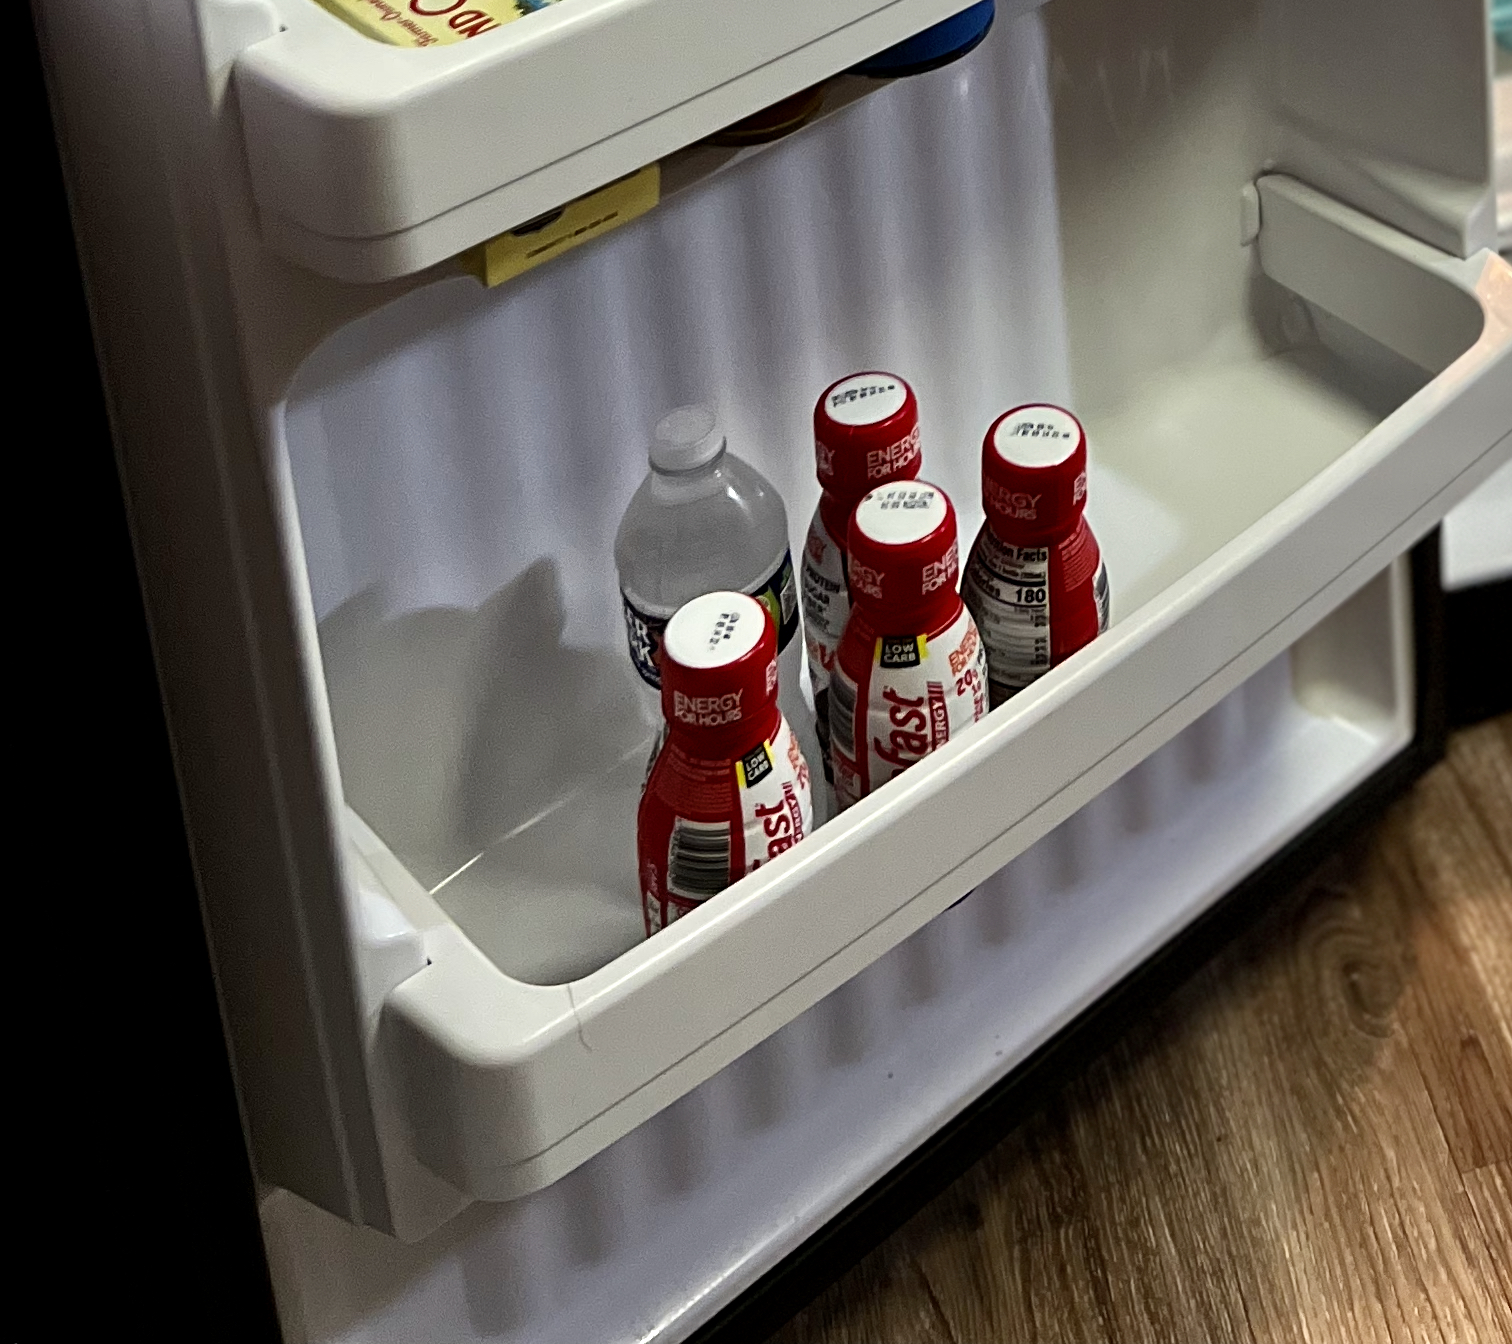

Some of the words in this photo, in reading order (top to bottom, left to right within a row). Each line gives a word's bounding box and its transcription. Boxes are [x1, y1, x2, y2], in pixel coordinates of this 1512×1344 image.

[448, 8, 502, 39] ND
[866, 422, 921, 468] ENERG
[867, 462, 892, 480] FOR
[1016, 547, 1047, 562] Facts
[1015, 588, 1046, 604] 180
[883, 652, 917, 663] CARB
[885, 642, 915, 653] LOW
[673, 687, 744, 714] ENERGY
[674, 706, 699, 725] FOR
[700, 706, 743, 727] HOURS
[873, 685, 929, 772] fast
[931, 699, 948, 750] NERGY
[745, 752, 766, 772] LOW
